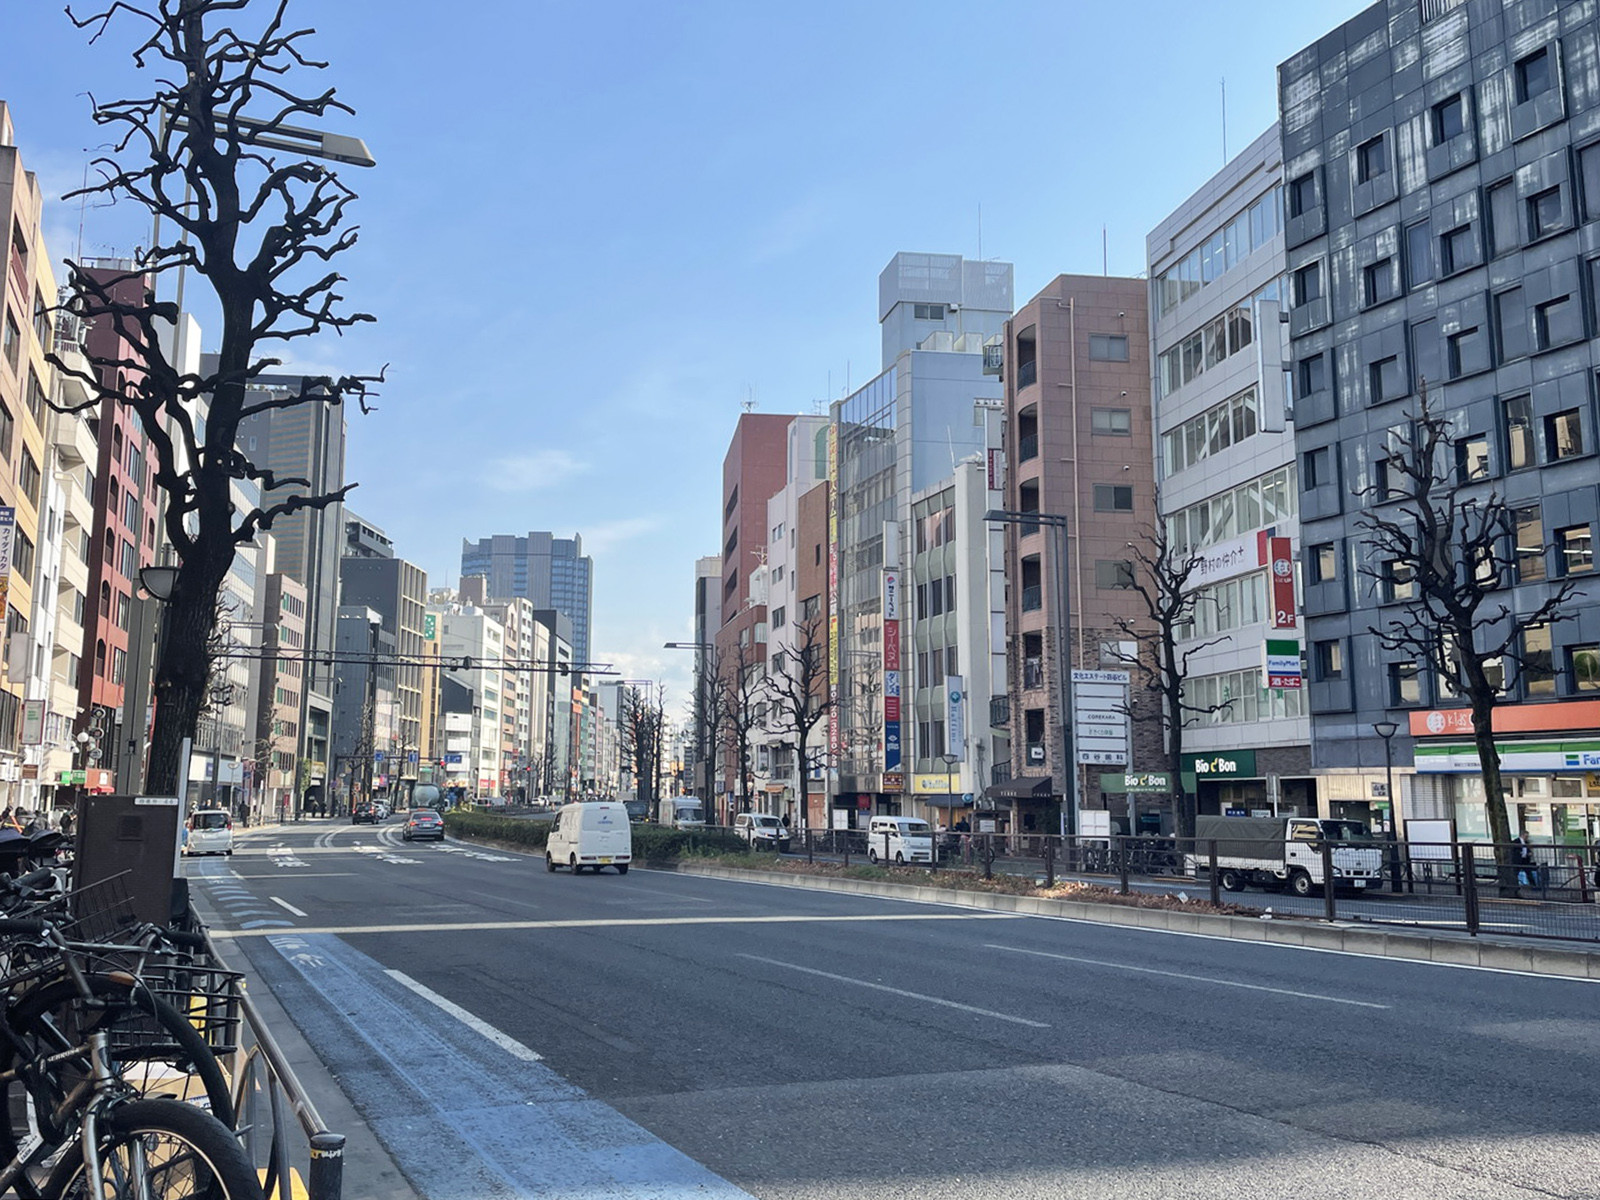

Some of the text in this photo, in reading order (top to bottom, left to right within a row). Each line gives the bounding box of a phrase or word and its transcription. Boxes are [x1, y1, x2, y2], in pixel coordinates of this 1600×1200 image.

[1277, 610, 1294, 624] 2F
[1268, 658, 1299, 667] FamilyMart
[1271, 676, 1300, 686] 酒・たばこ
[1195, 759, 1209, 773] Bio
[1218, 757, 1236, 772] Bon
[1124, 775, 1139, 786] Bio
[1148, 775, 1166, 786] Bon
